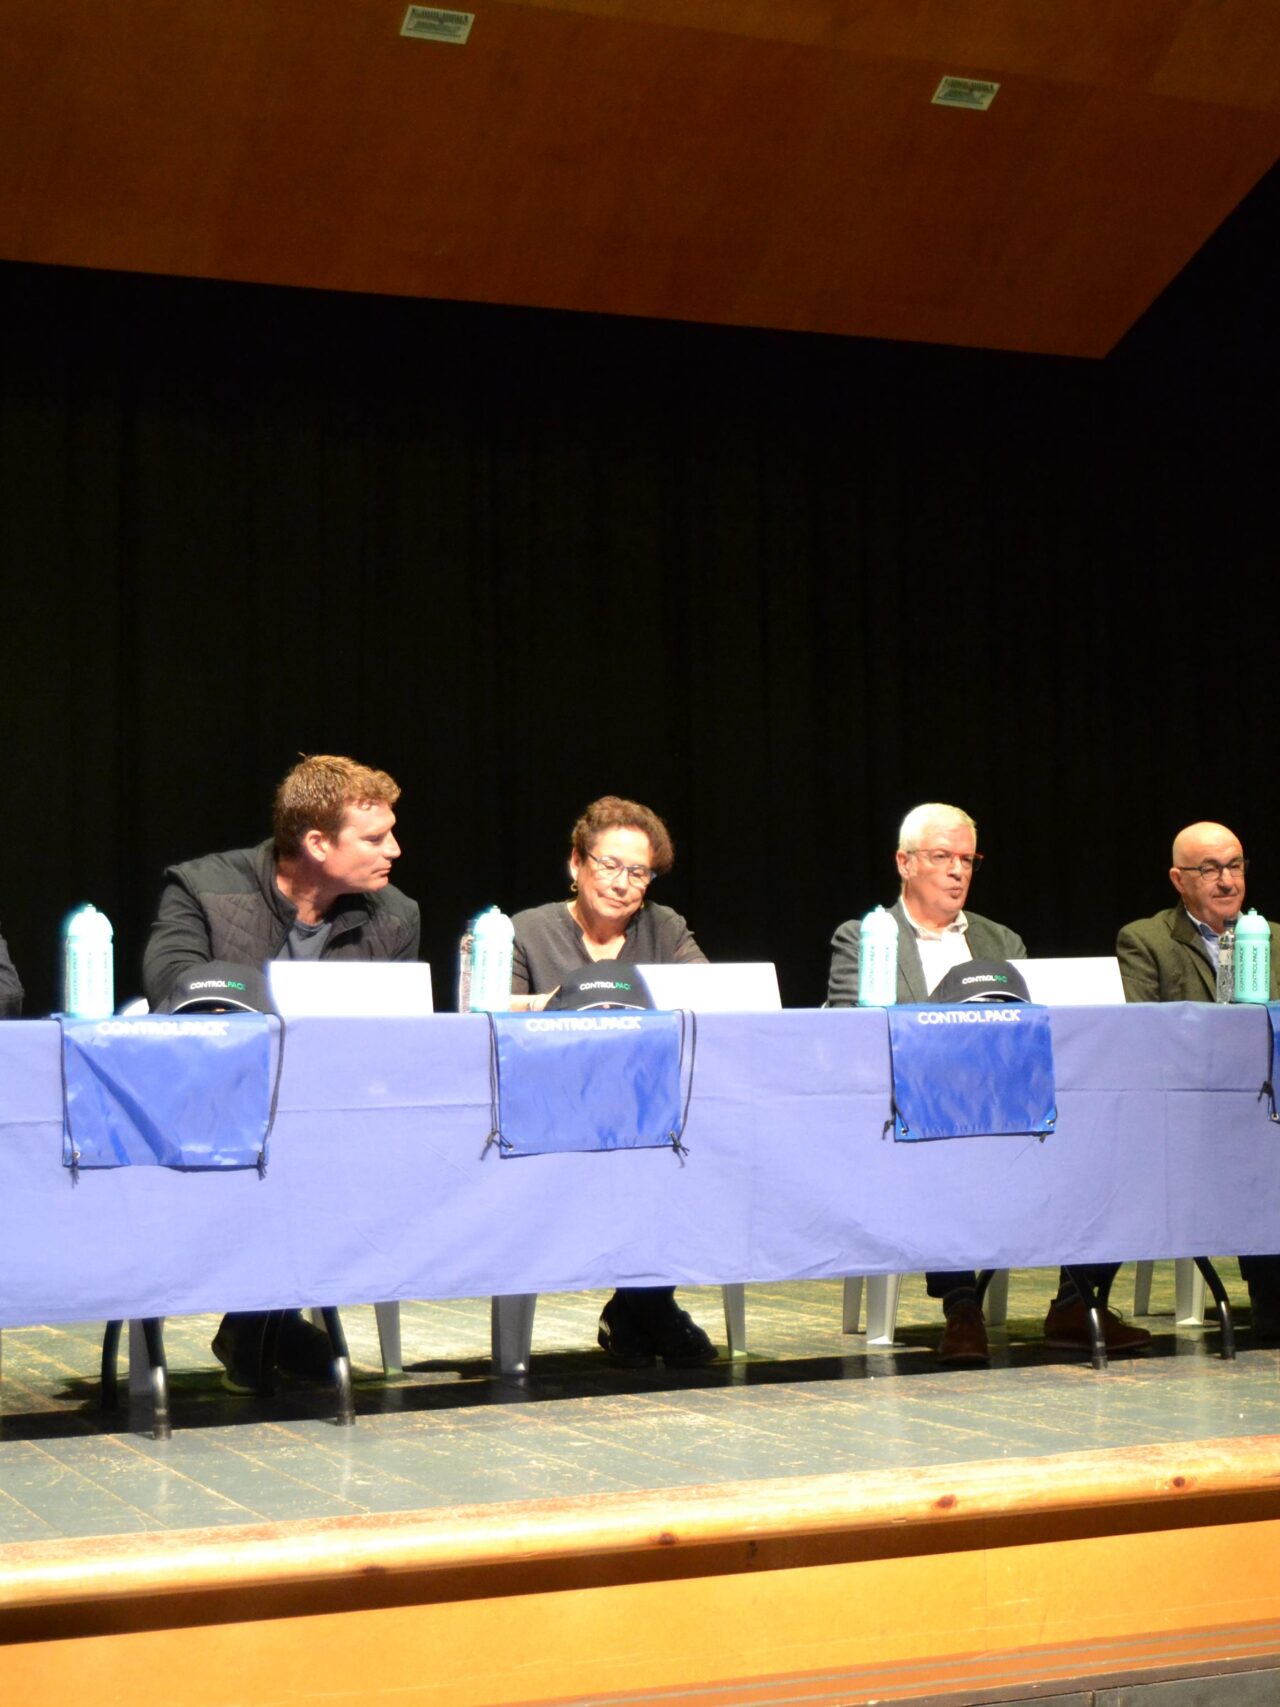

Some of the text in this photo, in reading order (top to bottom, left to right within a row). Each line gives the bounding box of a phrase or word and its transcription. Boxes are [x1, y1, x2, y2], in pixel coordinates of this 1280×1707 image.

[526, 1016, 643, 1032] CONTROLPACK
[917, 1010, 1022, 1025] CONTROLPACK
[96, 1021, 230, 1036] CONTROLPACK
